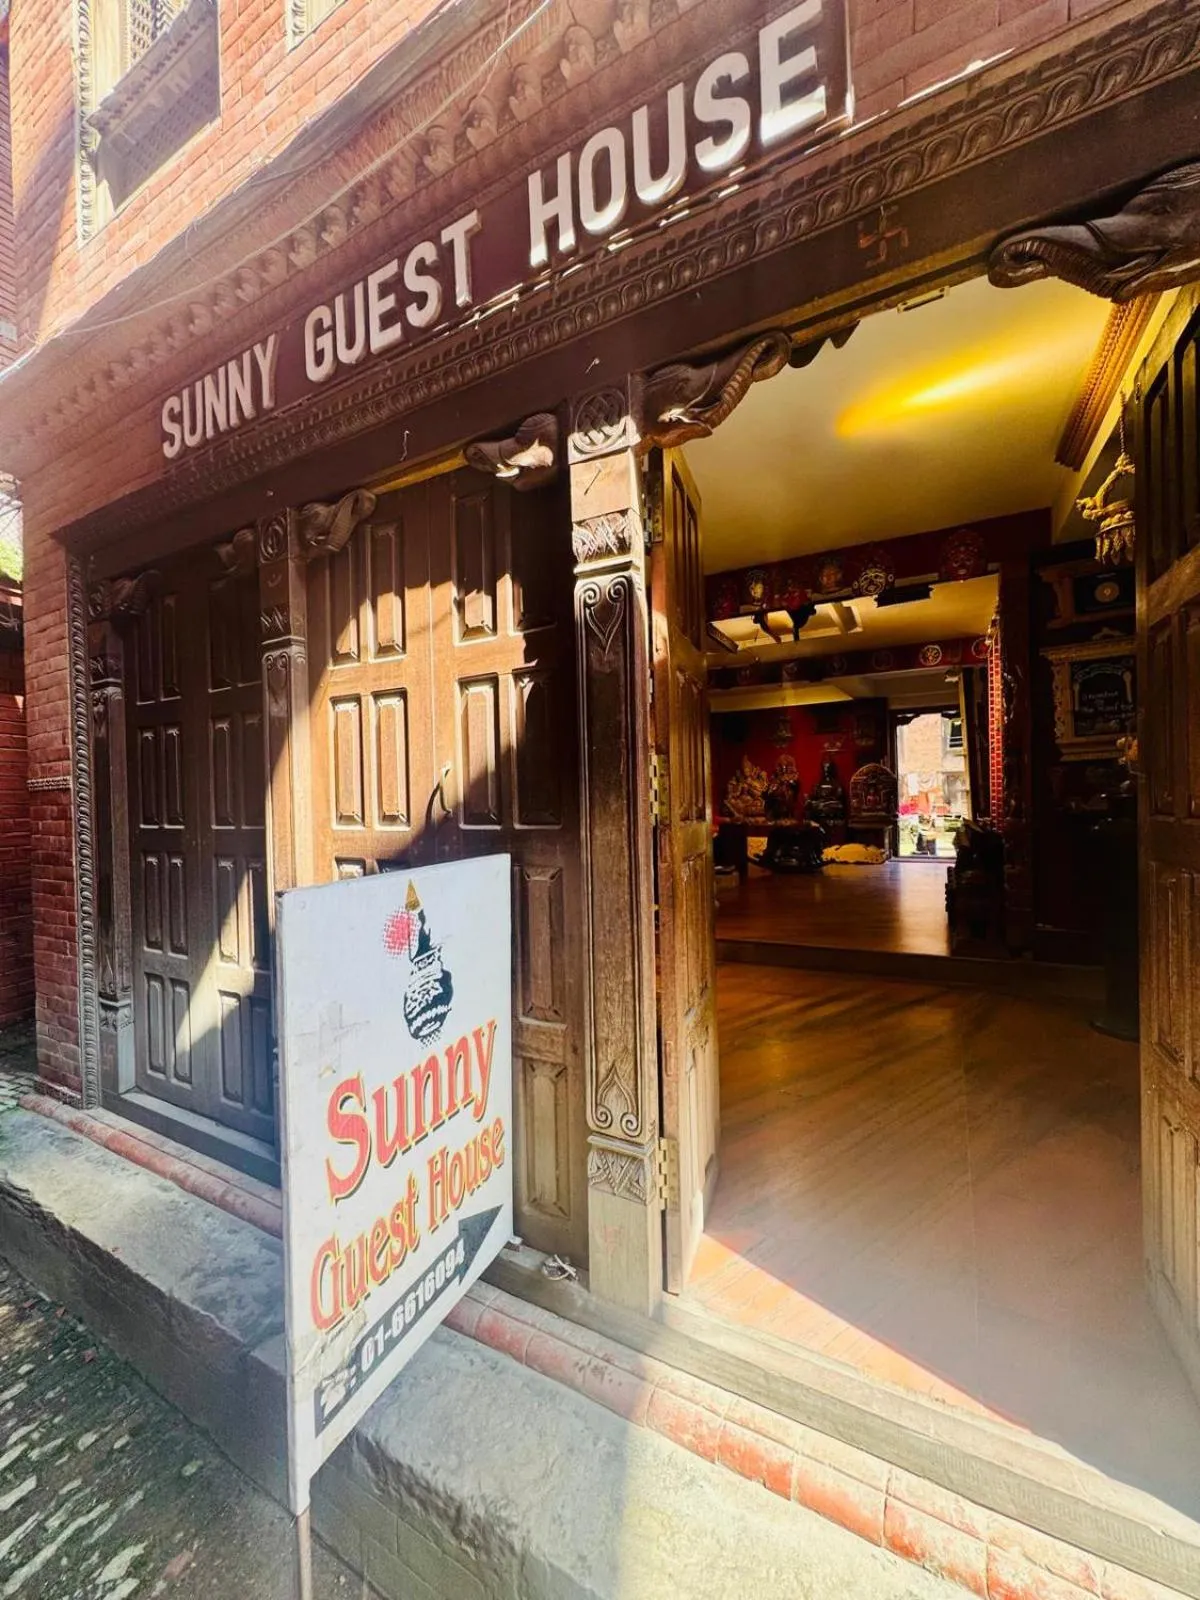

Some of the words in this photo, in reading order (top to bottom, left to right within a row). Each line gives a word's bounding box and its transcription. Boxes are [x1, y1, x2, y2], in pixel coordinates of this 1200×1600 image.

[161, 333, 276, 459] SUNNY
[304, 209, 482, 383] GUEST
[527, 0, 827, 268] HOUSE
[325, 1018, 497, 1206] Sunny
[310, 1169, 421, 1334] Guest
[426, 1116, 505, 1236] House
[361, 1237, 466, 1373] 01-6616094
